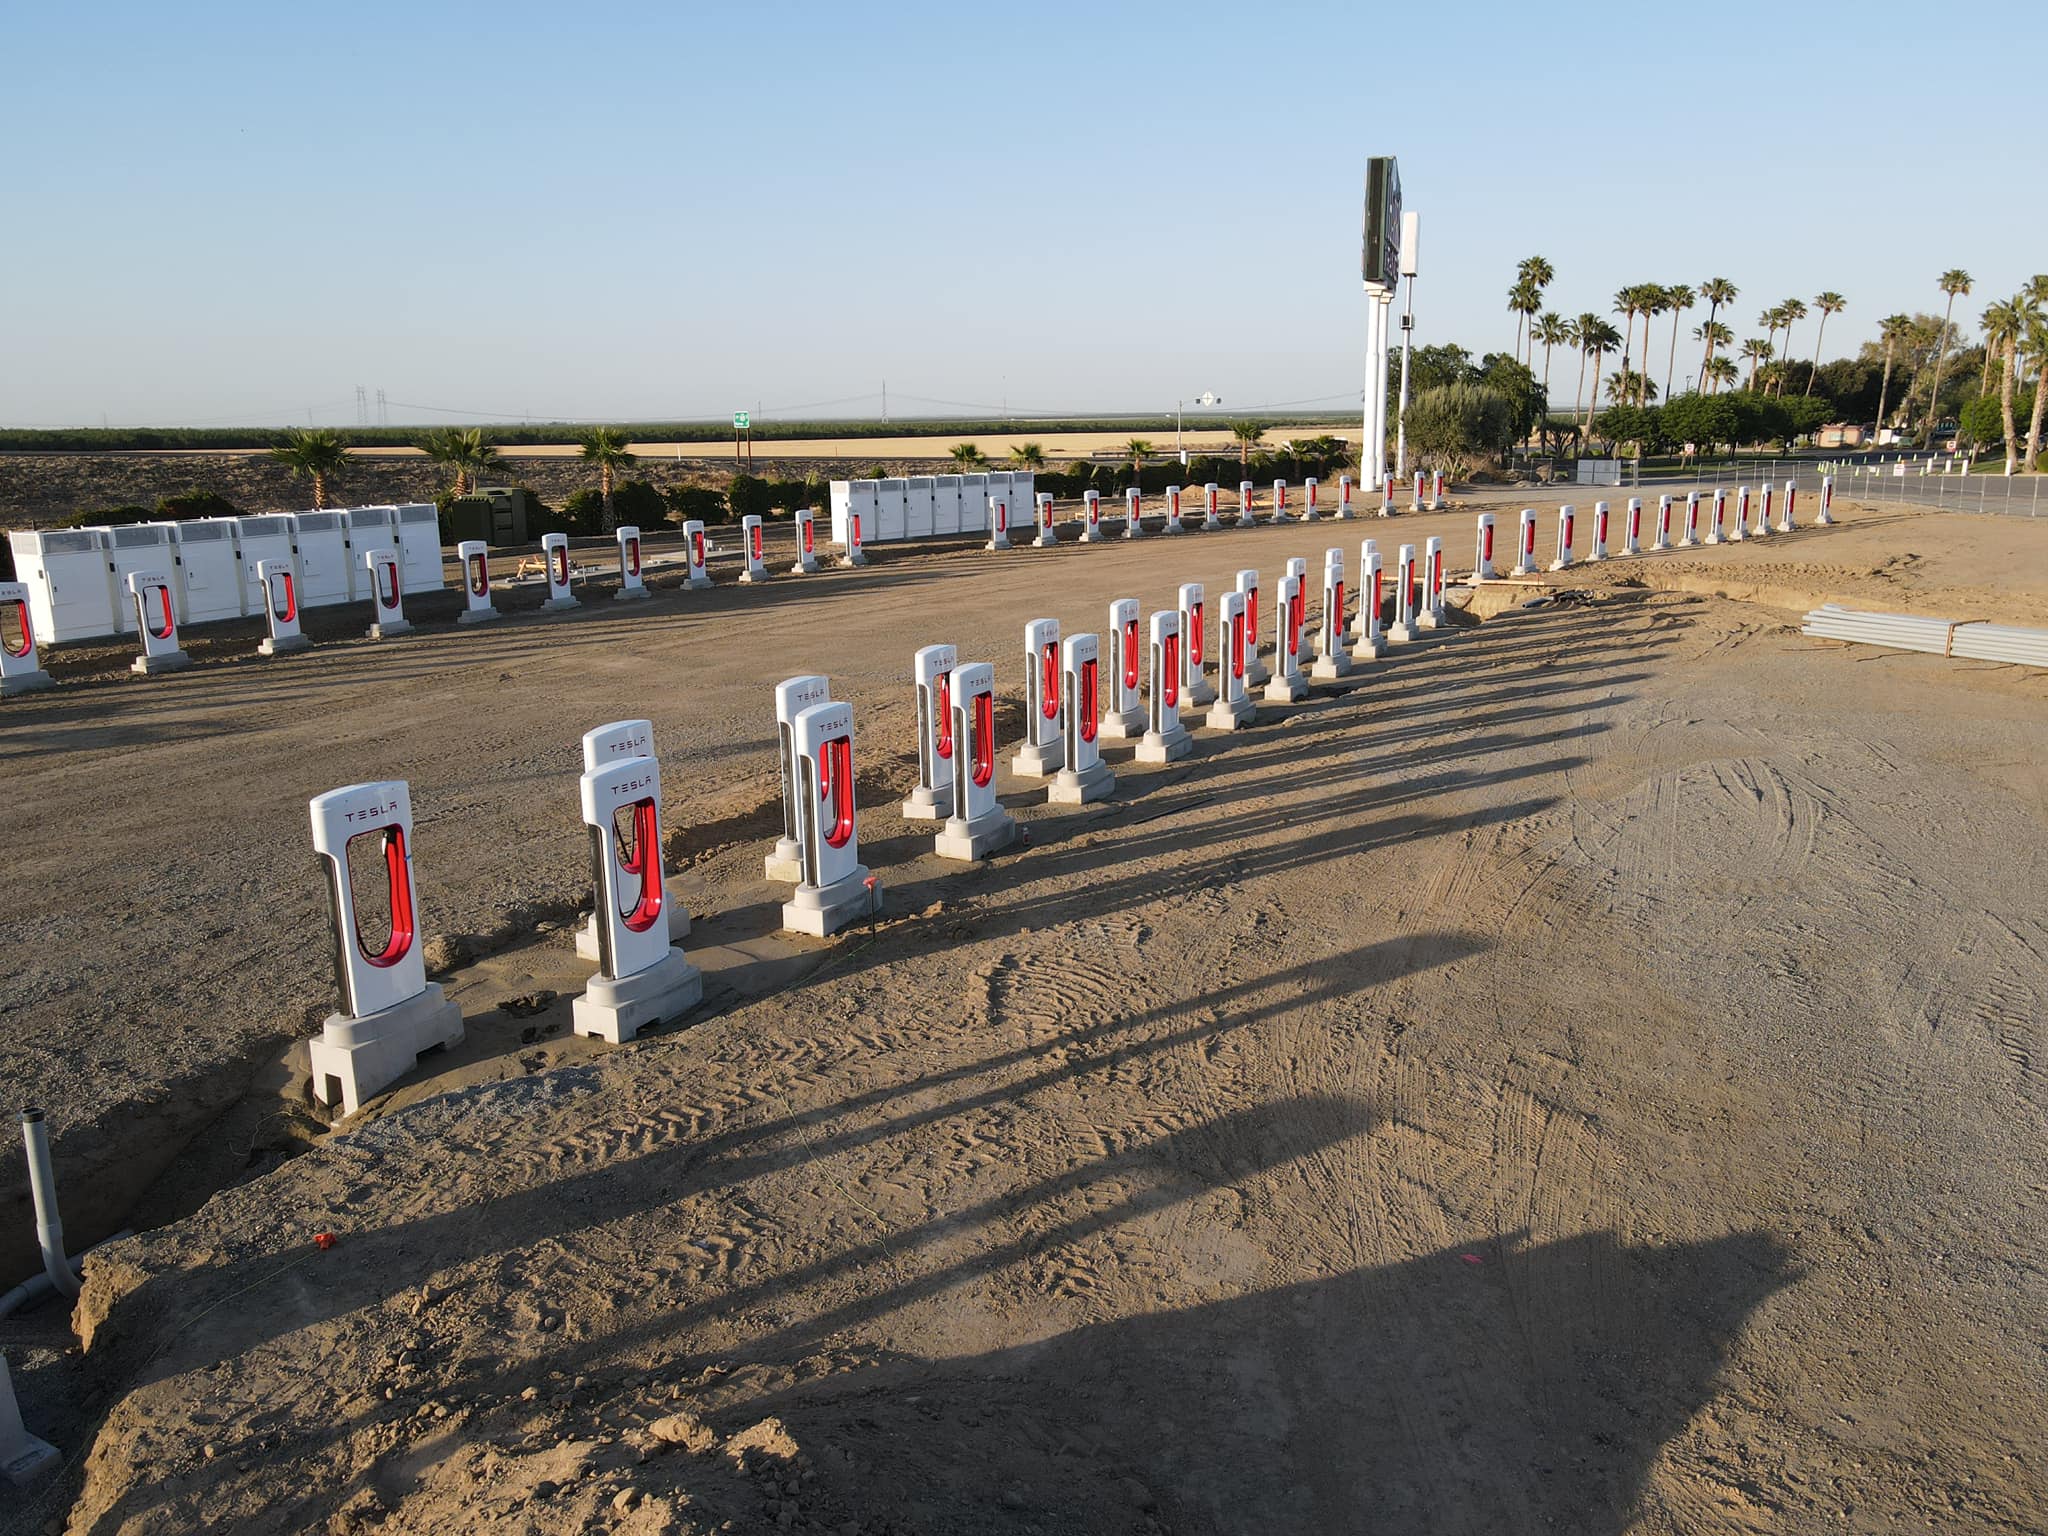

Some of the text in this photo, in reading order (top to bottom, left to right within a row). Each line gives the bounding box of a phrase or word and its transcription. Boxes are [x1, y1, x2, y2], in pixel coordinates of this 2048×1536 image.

[797, 688, 825, 702] TESLA
[819, 717, 849, 732] TESLA
[609, 736, 646, 753] TESLA
[611, 775, 652, 795] TESLA
[344, 801, 398, 822] TESLA
